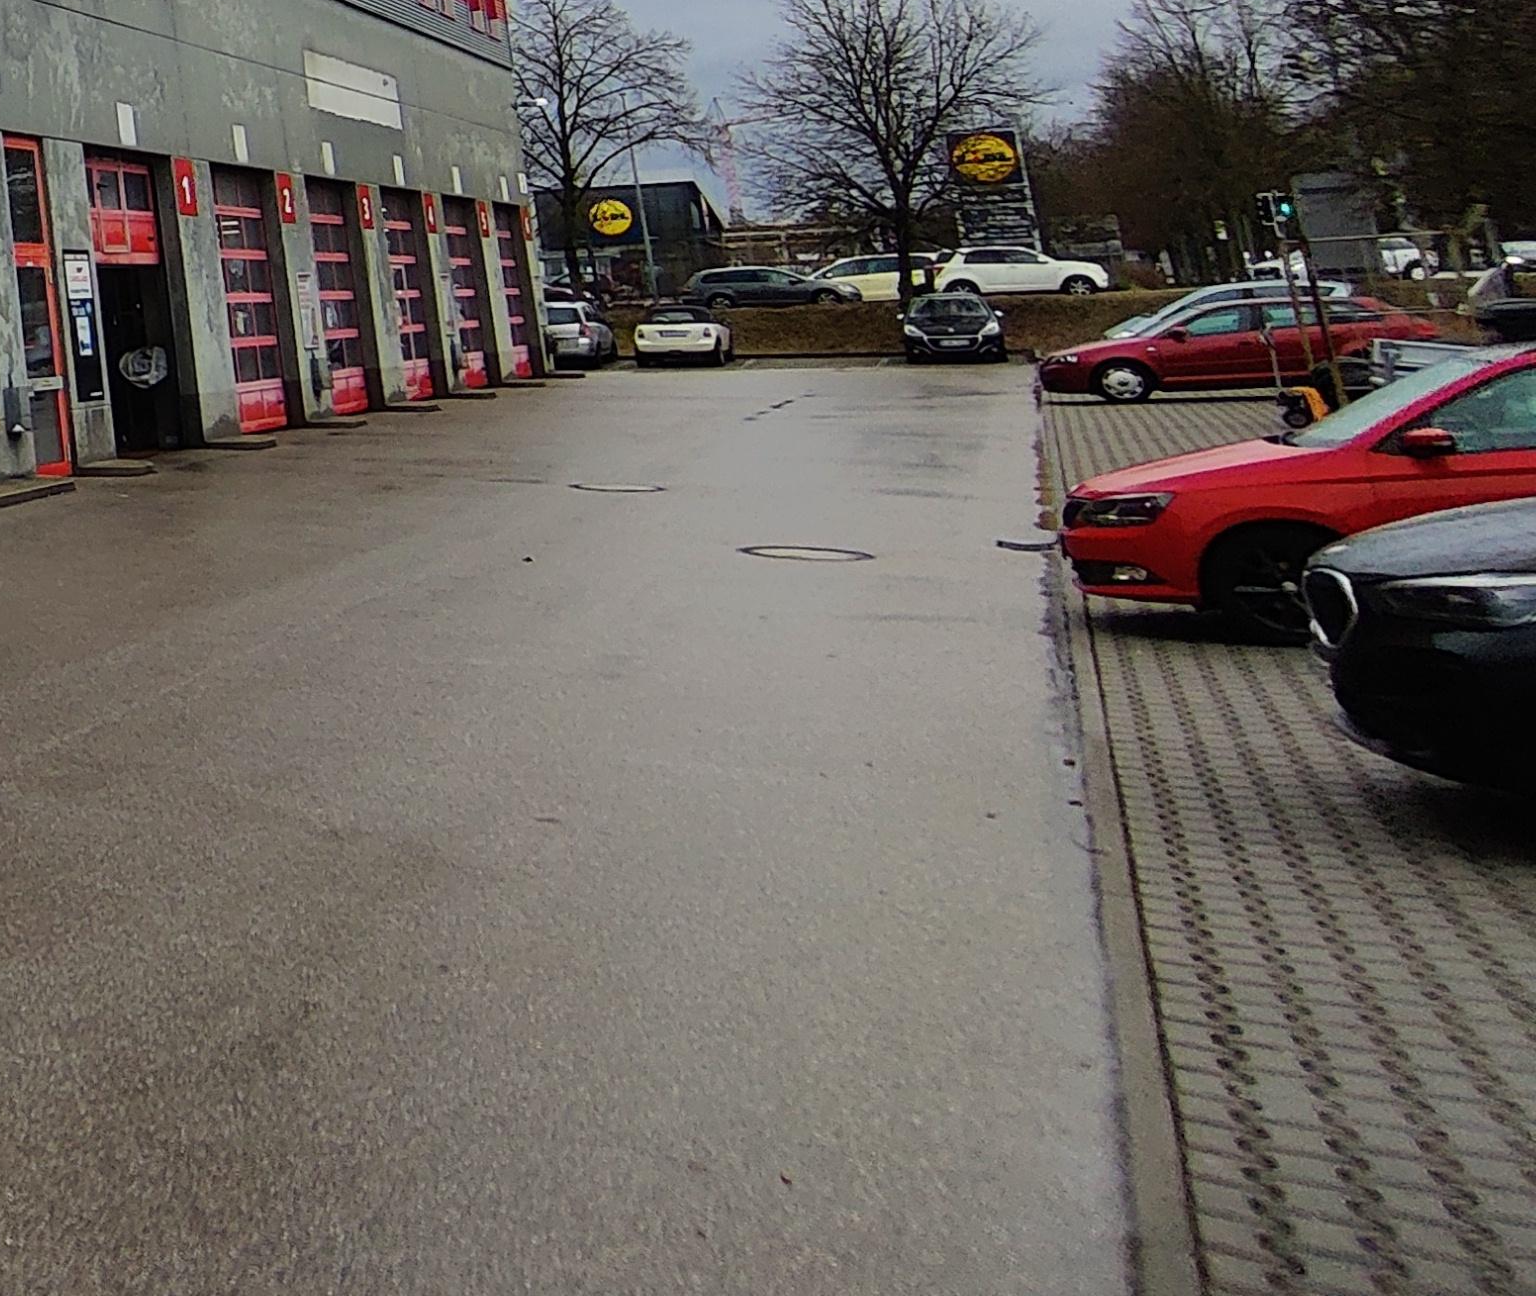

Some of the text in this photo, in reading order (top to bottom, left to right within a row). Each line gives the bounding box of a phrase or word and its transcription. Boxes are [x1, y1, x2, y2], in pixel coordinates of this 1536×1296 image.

[181, 175, 191, 205] 1
[282, 188, 293, 213] 2
[362, 197, 371, 221] 3
